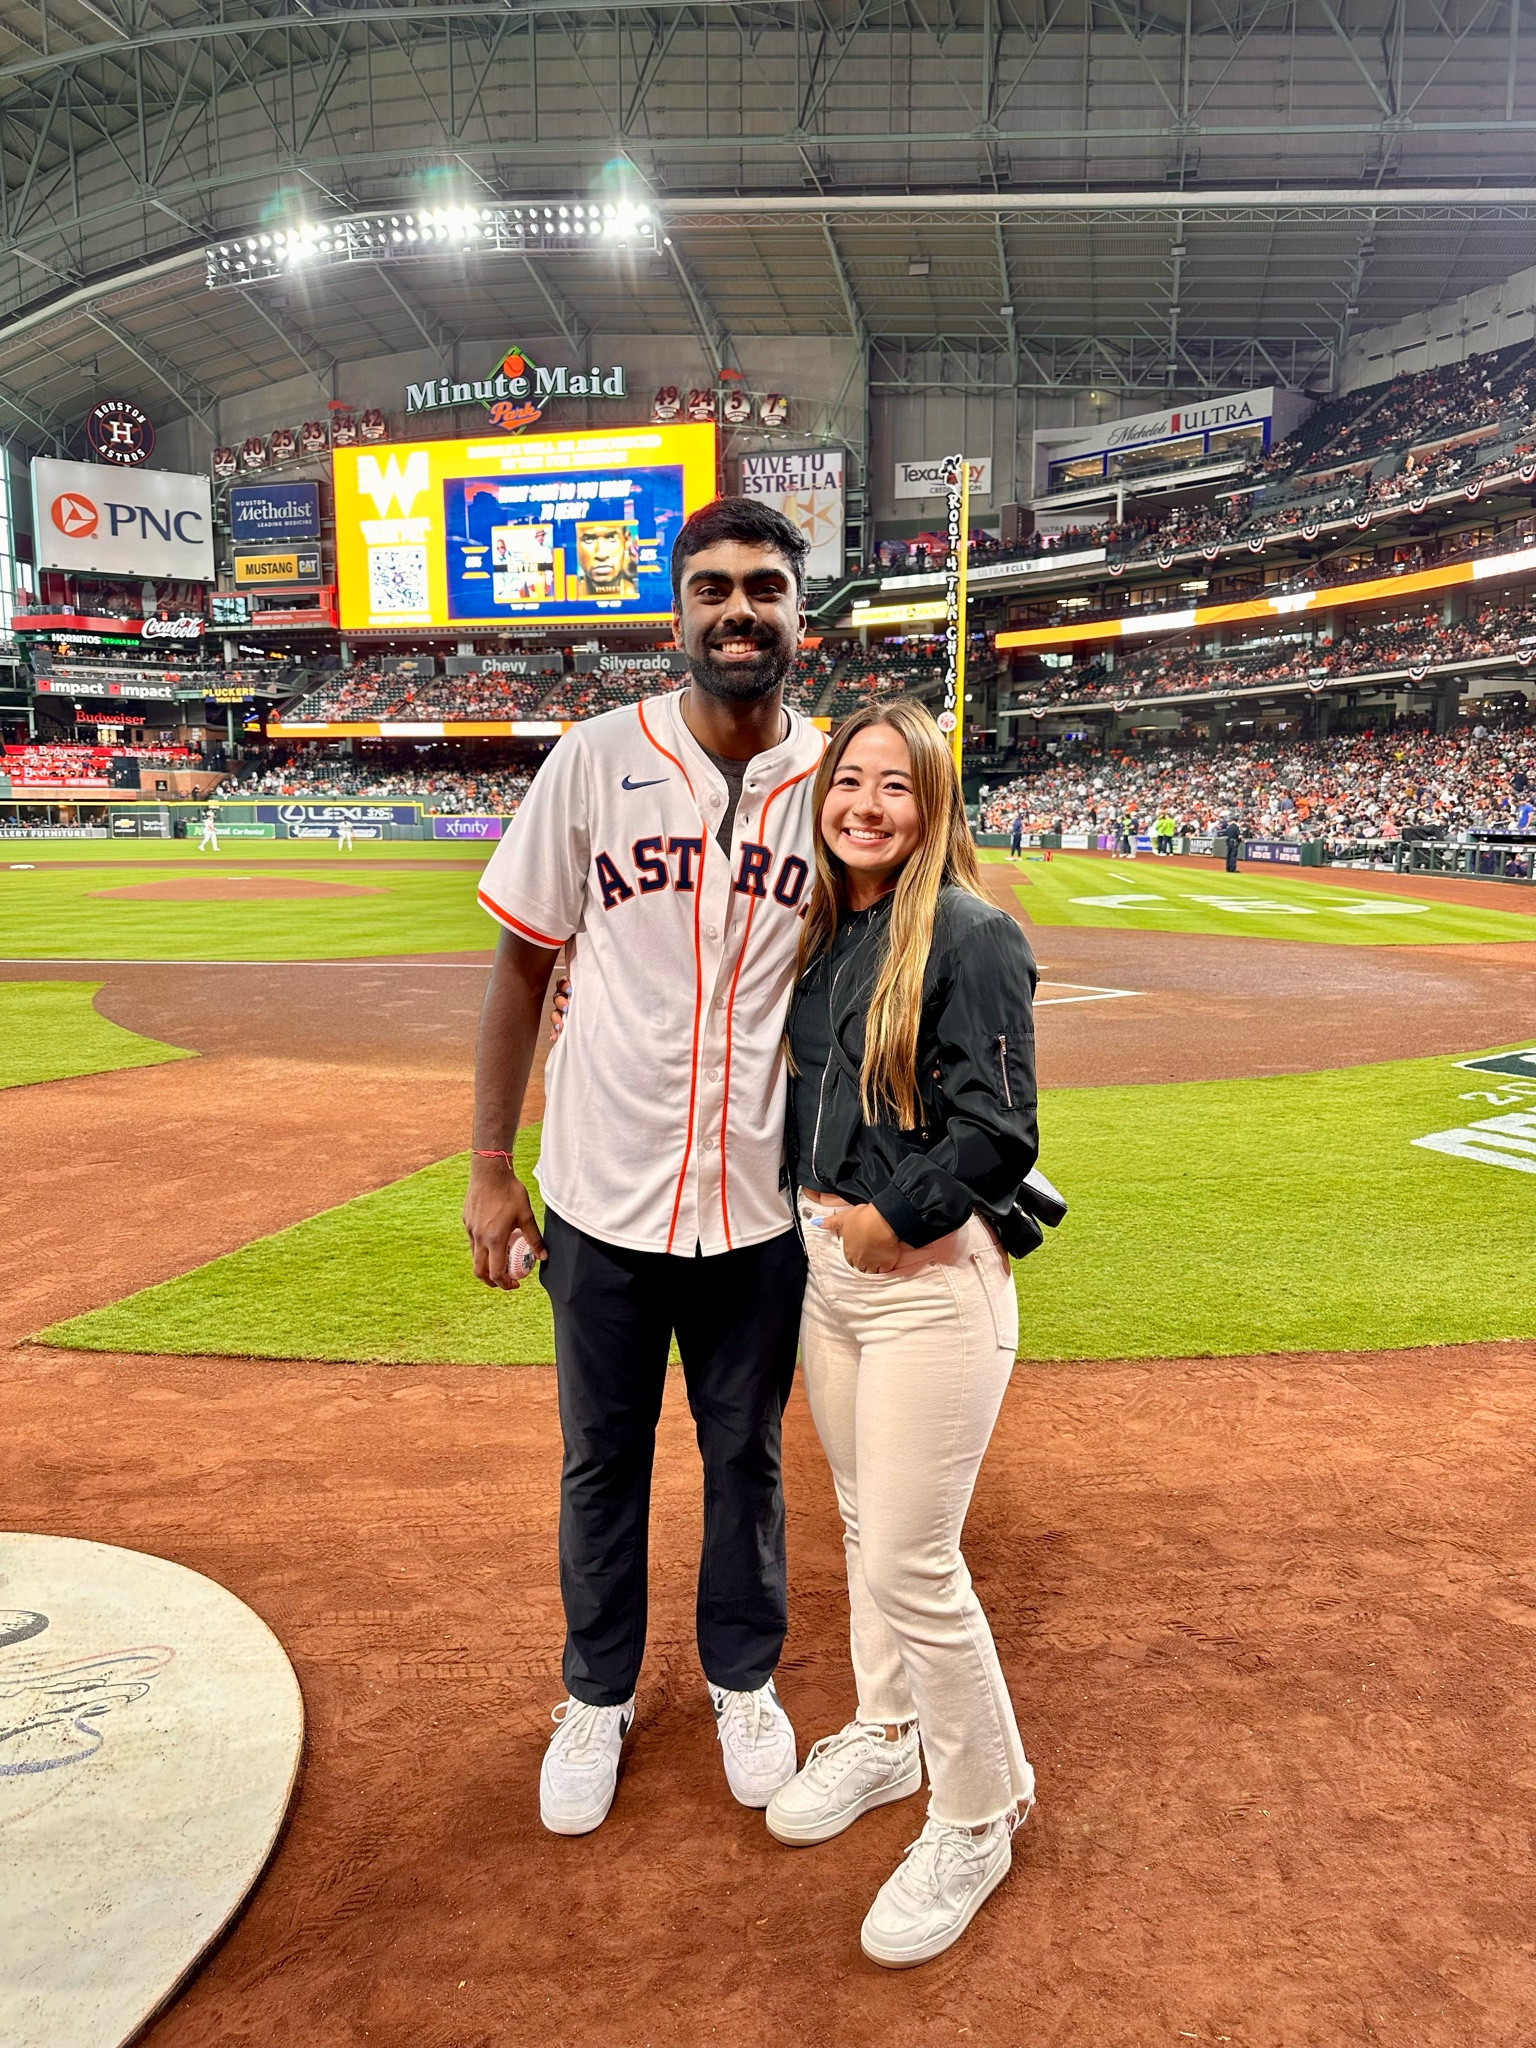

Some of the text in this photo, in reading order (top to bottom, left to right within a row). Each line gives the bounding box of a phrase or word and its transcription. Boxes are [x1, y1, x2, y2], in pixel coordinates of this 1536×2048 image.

[405, 366, 625, 412] Minute Maid
[654, 386, 678, 406] 49
[688, 388, 713, 408] 24
[731, 390, 743, 410] 5
[94, 402, 147, 424] HOUSTON
[361, 409, 382, 428] 42
[488, 401, 541, 426] Park
[109, 421, 135, 444] H
[302, 421, 322, 440] 33
[332, 414, 353, 433] 34
[1107, 401, 1254, 446] Michelob ULTRA
[242, 437, 263, 456] 40
[271, 429, 293, 448] 25
[99, 444, 146, 463] ASTROS
[213, 447, 234, 465] 32
[803, 454, 825, 472] TU
[236, 500, 313, 521] Methodist
[103, 502, 205, 545] PNC
[257, 518, 313, 528] LEADING MEDICINE
[245, 561, 293, 575] MUSTANG
[298, 560, 317, 573] CAT
[51, 633, 101, 645] HORNITOS
[482, 659, 527, 674] Chevy
[599, 655, 671, 671] Silverado
[49, 679, 105, 695] impact
[119, 683, 173, 699] impact
[202, 688, 256, 697] PLUCKERS
[75, 710, 147, 725] Budweiser
[31, 830, 87, 838] FURNITURE
[445, 819, 490, 837] xfinity
[595, 835, 813, 920] ASTRO
